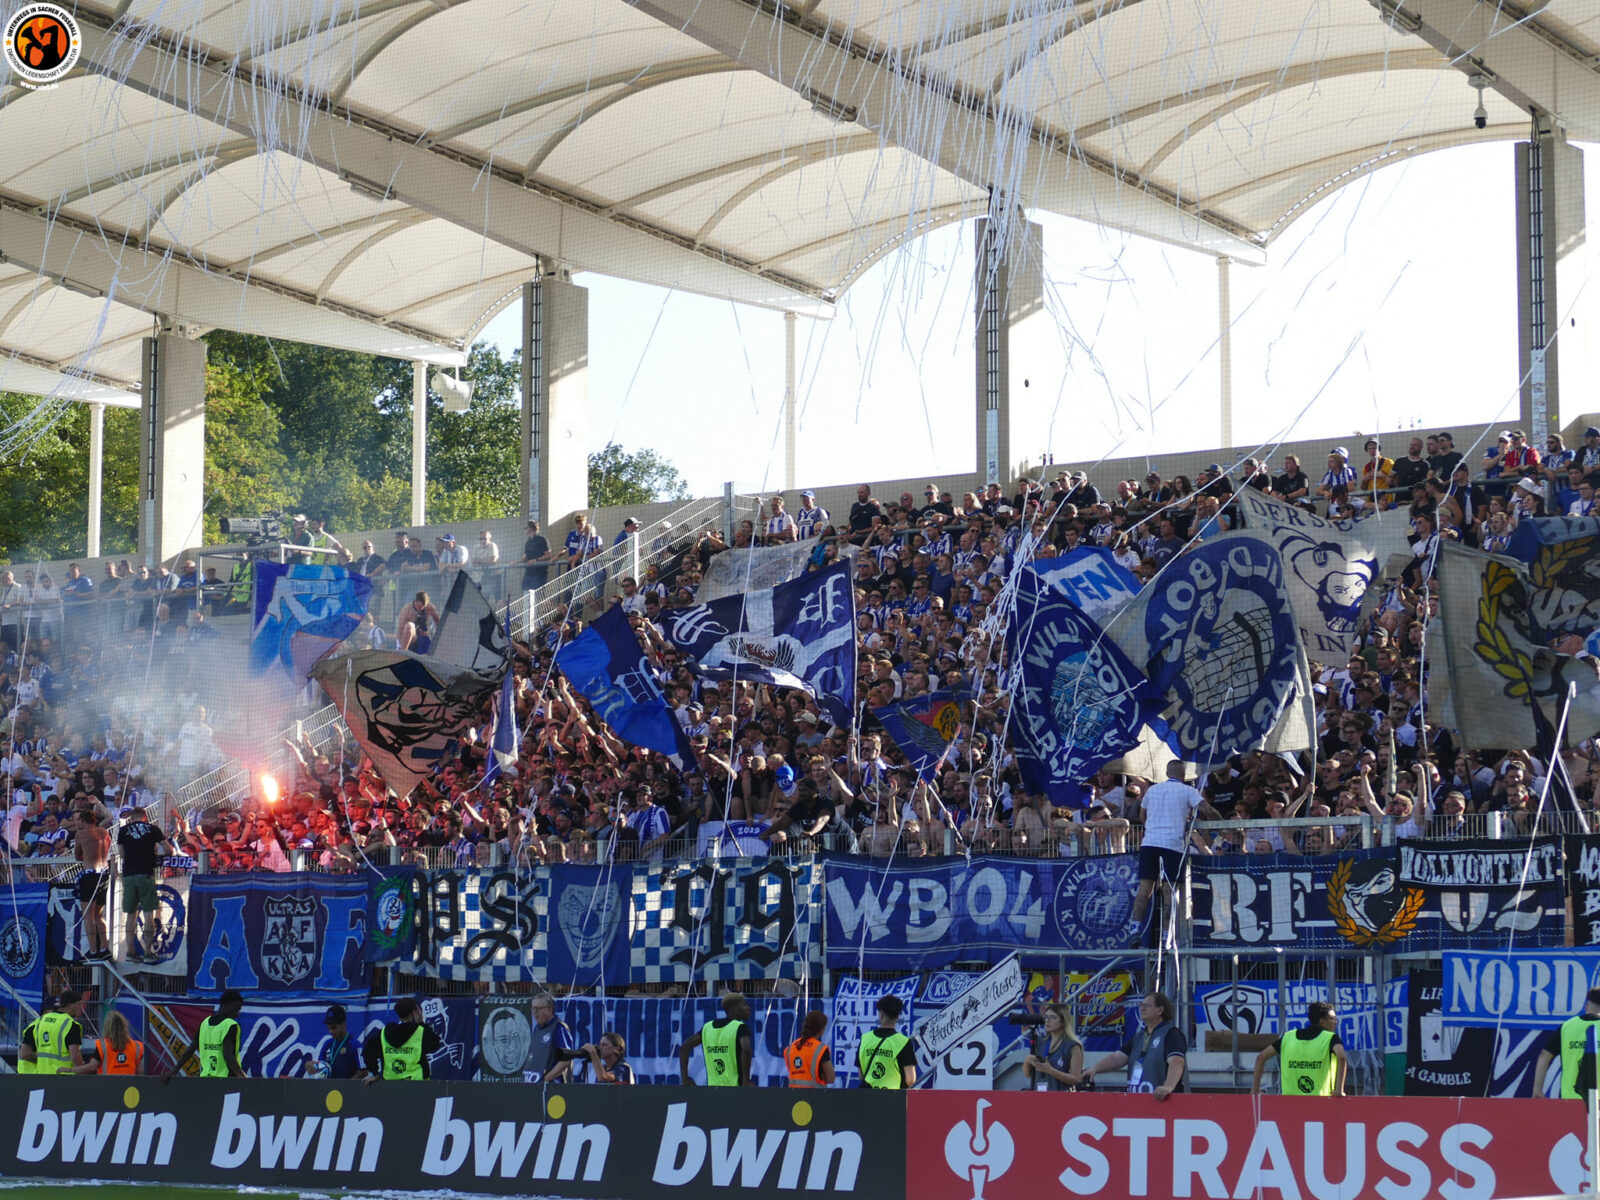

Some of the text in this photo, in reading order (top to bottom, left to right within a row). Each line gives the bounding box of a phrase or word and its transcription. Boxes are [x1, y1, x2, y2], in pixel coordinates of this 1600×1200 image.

[1249, 497, 1303, 526] DER
[1026, 617, 1085, 670] WILD
[1063, 862, 1097, 898] WILD
[269, 902, 311, 914] ULTRAS
[841, 980, 918, 997] NERVEN
[1449, 957, 1588, 1016] NORD
[424, 1001, 439, 1014] 99
[943, 1041, 987, 1076] C2
[1288, 1060, 1323, 1070] SICHERHEIT
[1418, 1070, 1472, 1086] GAMBLE
[16, 1086, 178, 1166] bwin
[210, 1089, 384, 1173] bwin
[420, 1094, 611, 1182] bwin
[652, 1100, 864, 1192] bwin
[1058, 1115, 1496, 1200] STRAUSS
